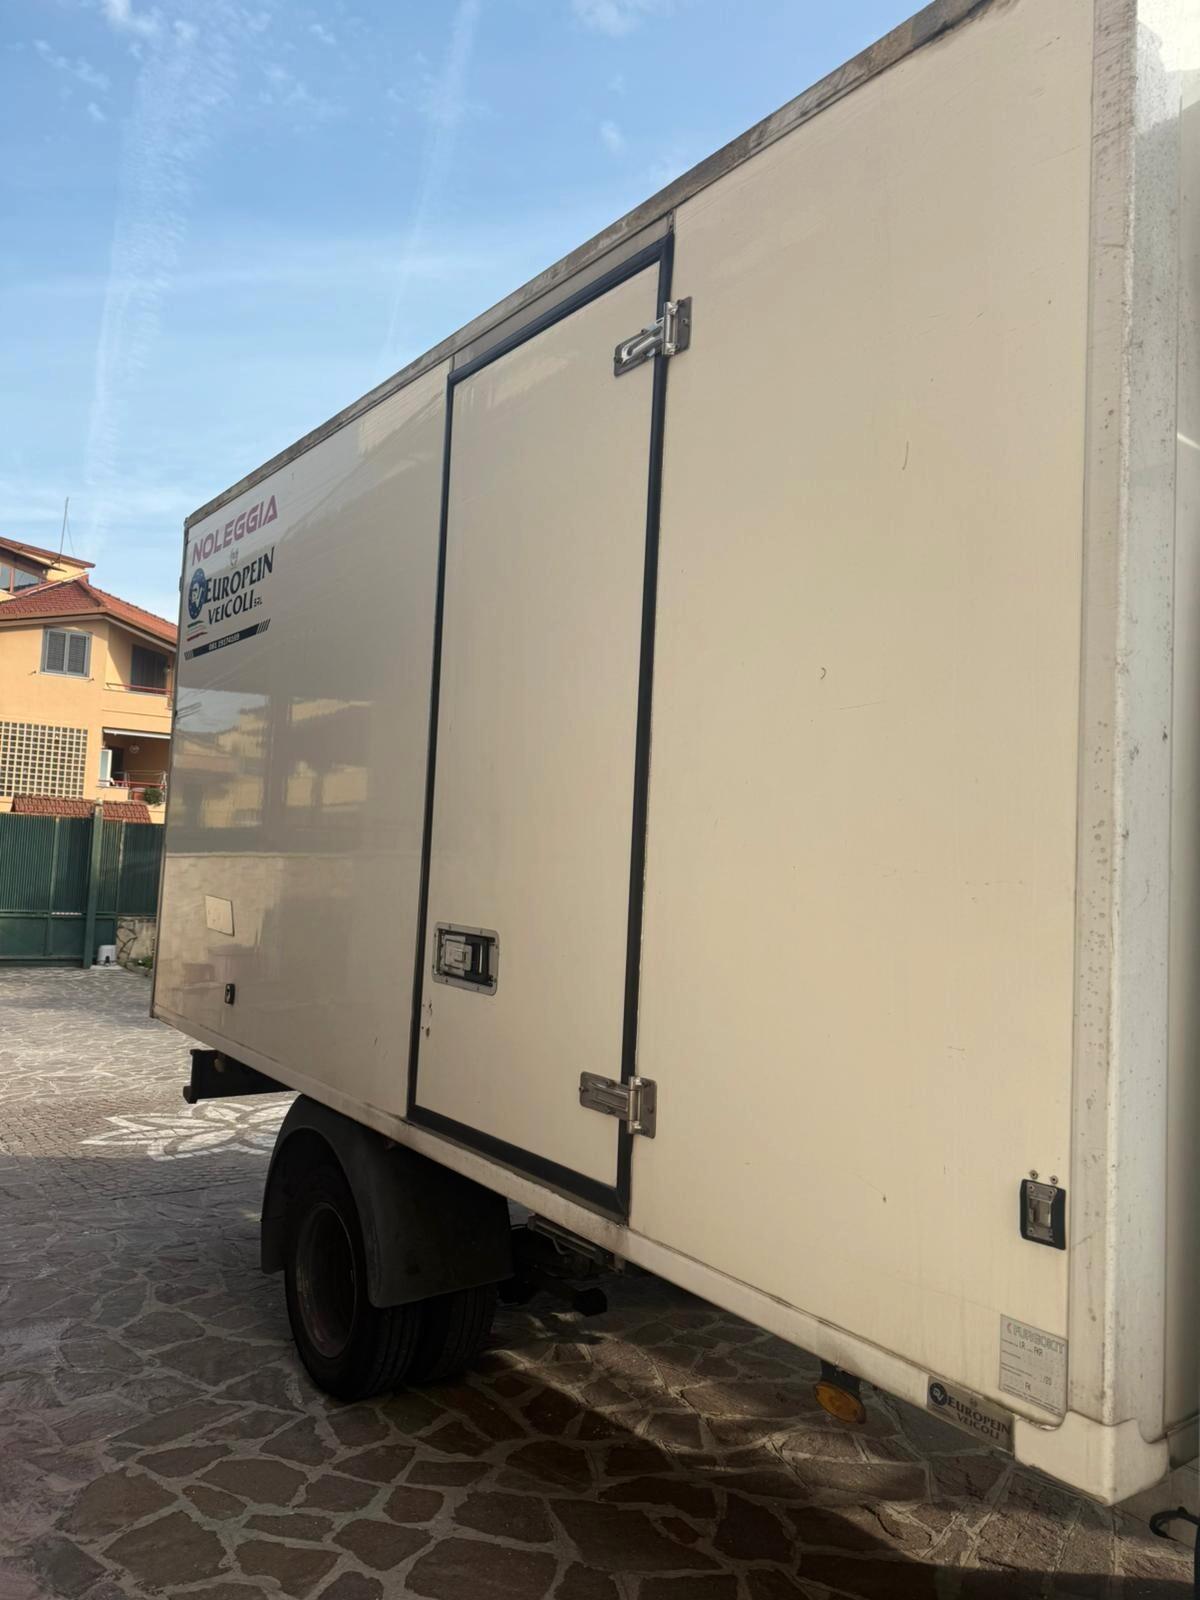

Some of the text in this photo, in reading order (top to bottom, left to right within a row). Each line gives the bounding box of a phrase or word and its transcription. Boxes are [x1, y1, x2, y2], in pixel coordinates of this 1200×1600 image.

[192, 494, 278, 567] NOLEGGIA
[204, 546, 276, 604] EUROPEIN
[208, 589, 255, 626] VEICOLI
[947, 1396, 1010, 1436] EUROPEIN
[957, 1412, 1000, 1441] VEICOLI
